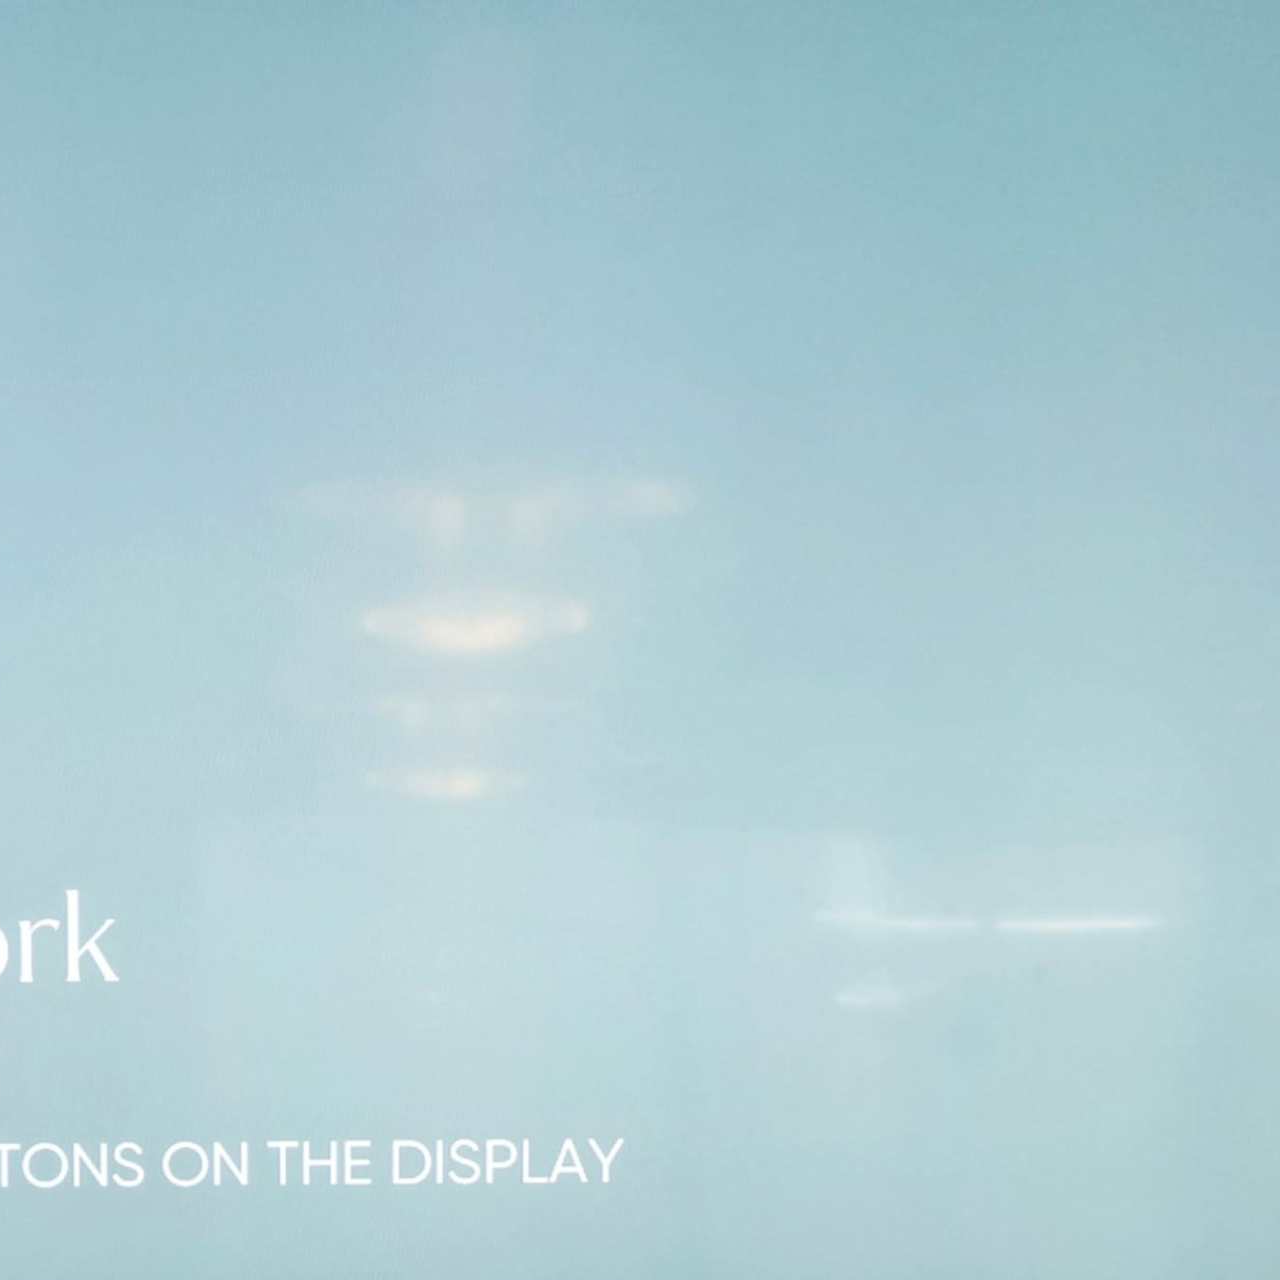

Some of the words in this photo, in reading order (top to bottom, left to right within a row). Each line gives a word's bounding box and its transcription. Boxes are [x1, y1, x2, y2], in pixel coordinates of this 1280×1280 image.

[160, 1139, 250, 1189] ON
[265, 1138, 373, 1187] THE
[390, 1136, 626, 1187] DISPLAY
